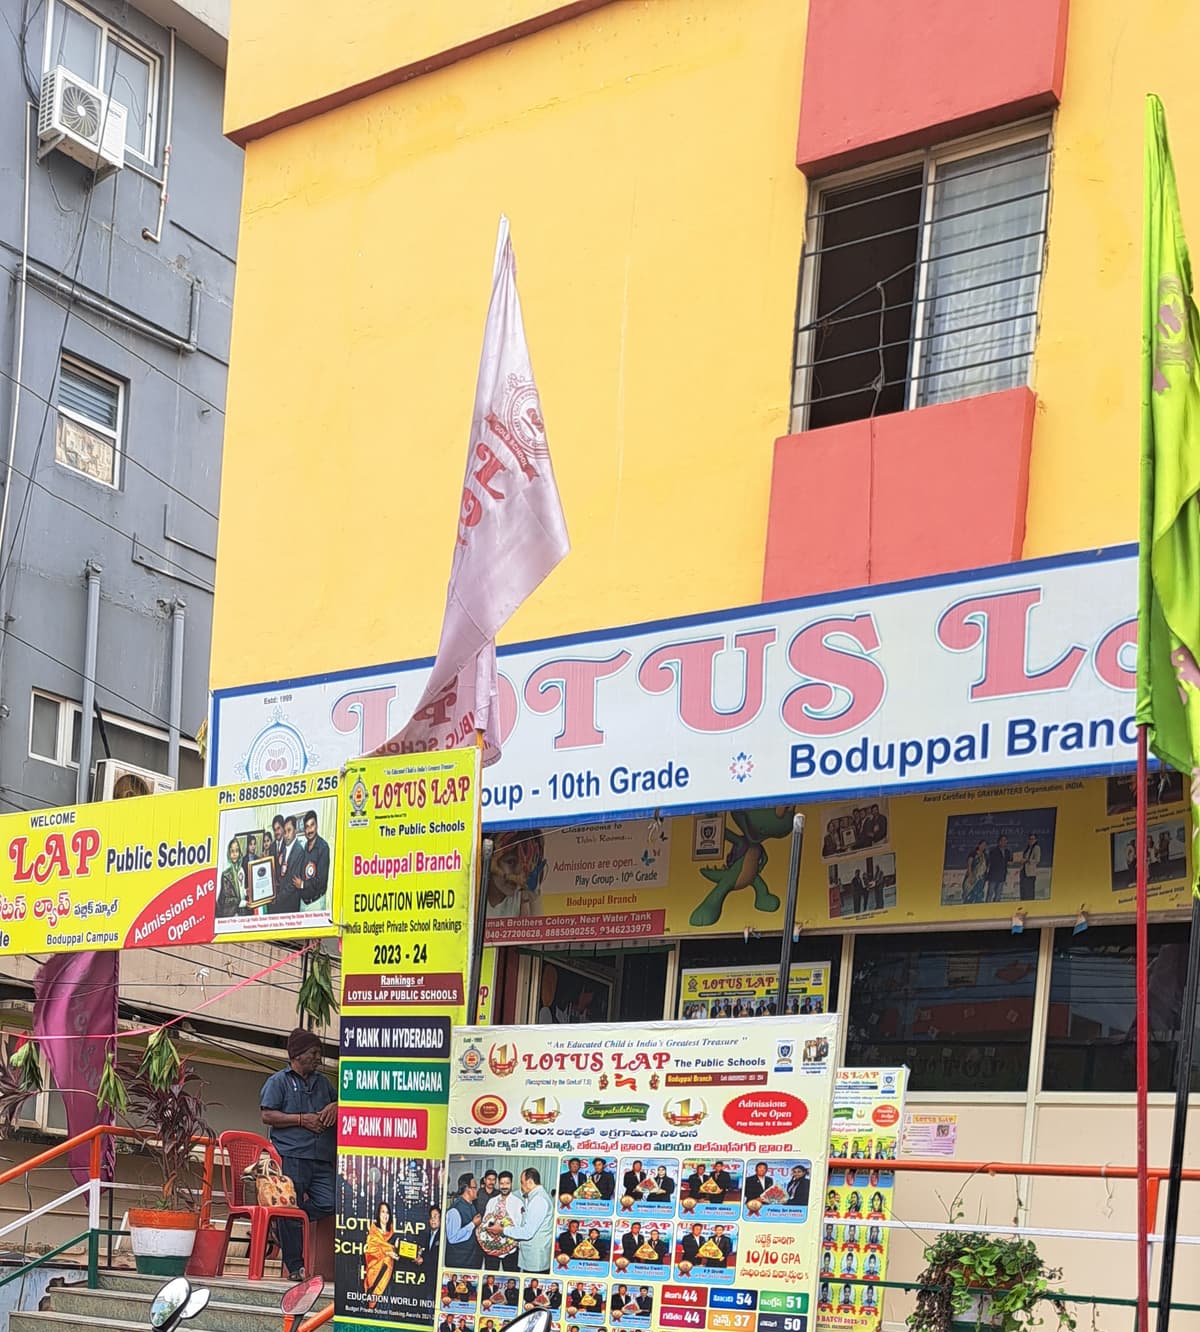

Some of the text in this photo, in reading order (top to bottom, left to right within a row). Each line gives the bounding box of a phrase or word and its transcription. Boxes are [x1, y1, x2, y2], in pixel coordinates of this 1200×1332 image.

[789, 714, 1138, 783] Boduppal Branc
[219, 775, 338, 804] Ph: 8885090255 256
[372, 775, 470, 809] LOTUS LAP
[482, 762, 690, 811] oup 10th Grade
[30, 812, 76, 828] WELCOME
[379, 819, 465, 837] The Public Schools
[9, 829, 211, 883] LAP Public School
[354, 850, 461, 879] Boduppal Branch
[553, 859, 611, 872] Admissions are
[575, 874, 589, 887] Play
[591, 873, 615, 886] Group
[635, 870, 658, 882] Grade
[354, 891, 412, 913] EDUCATION
[566, 894, 637, 908] Boduppal Branch
[134, 894, 193, 943] Admissions
[196, 879, 214, 898] Are
[363, 918, 462, 935] Budget Private School Rankings
[507, 912, 651, 928] Brothers Colony, Near Water Tank
[47, 931, 119, 947] Boduppal Campus
[374, 944, 427, 964] 2023 24
[381, 975, 424, 987] Rankings of
[702, 978, 743, 990] LOTUS
[745, 976, 775, 988] LAP
[347, 989, 458, 1001] LOTUS LAP PUBLIC SCHOOLS
[356, 1028, 379, 1048] RANK
[382, 1028, 390, 1048] IN
[392, 1028, 444, 1049] HYDERABAD
[553, 1037, 739, 1049] An Educated Child is India's Greatest Treasure
[522, 1051, 766, 1073] LOTUS LAP The Public Schools
[356, 1070, 379, 1090] RANK
[381, 1071, 390, 1091] IN
[392, 1071, 442, 1092] TELANGANA
[693, 1074, 713, 1083] Branch
[739, 1099, 787, 1109] Admissions
[751, 1109, 792, 1120] Are Open
[358, 1117, 381, 1137] RANK
[383, 1117, 393, 1138] IN
[394, 1118, 417, 1139] INDIA
[450, 1126, 472, 1135] SSC
[525, 1128, 554, 1136] 100%
[661, 1129, 698, 1138] నిలిచిన
[745, 1250, 801, 1267] 10/10 GPA
[347, 1291, 435, 1309] EDUCATION WORLD INDI
[682, 1290, 698, 1302] 44
[736, 1293, 752, 1306] 54
[786, 1296, 802, 1309] 51
[684, 1311, 700, 1324] 44
[734, 1315, 750, 1327] 37
[784, 1318, 801, 1332] 50
